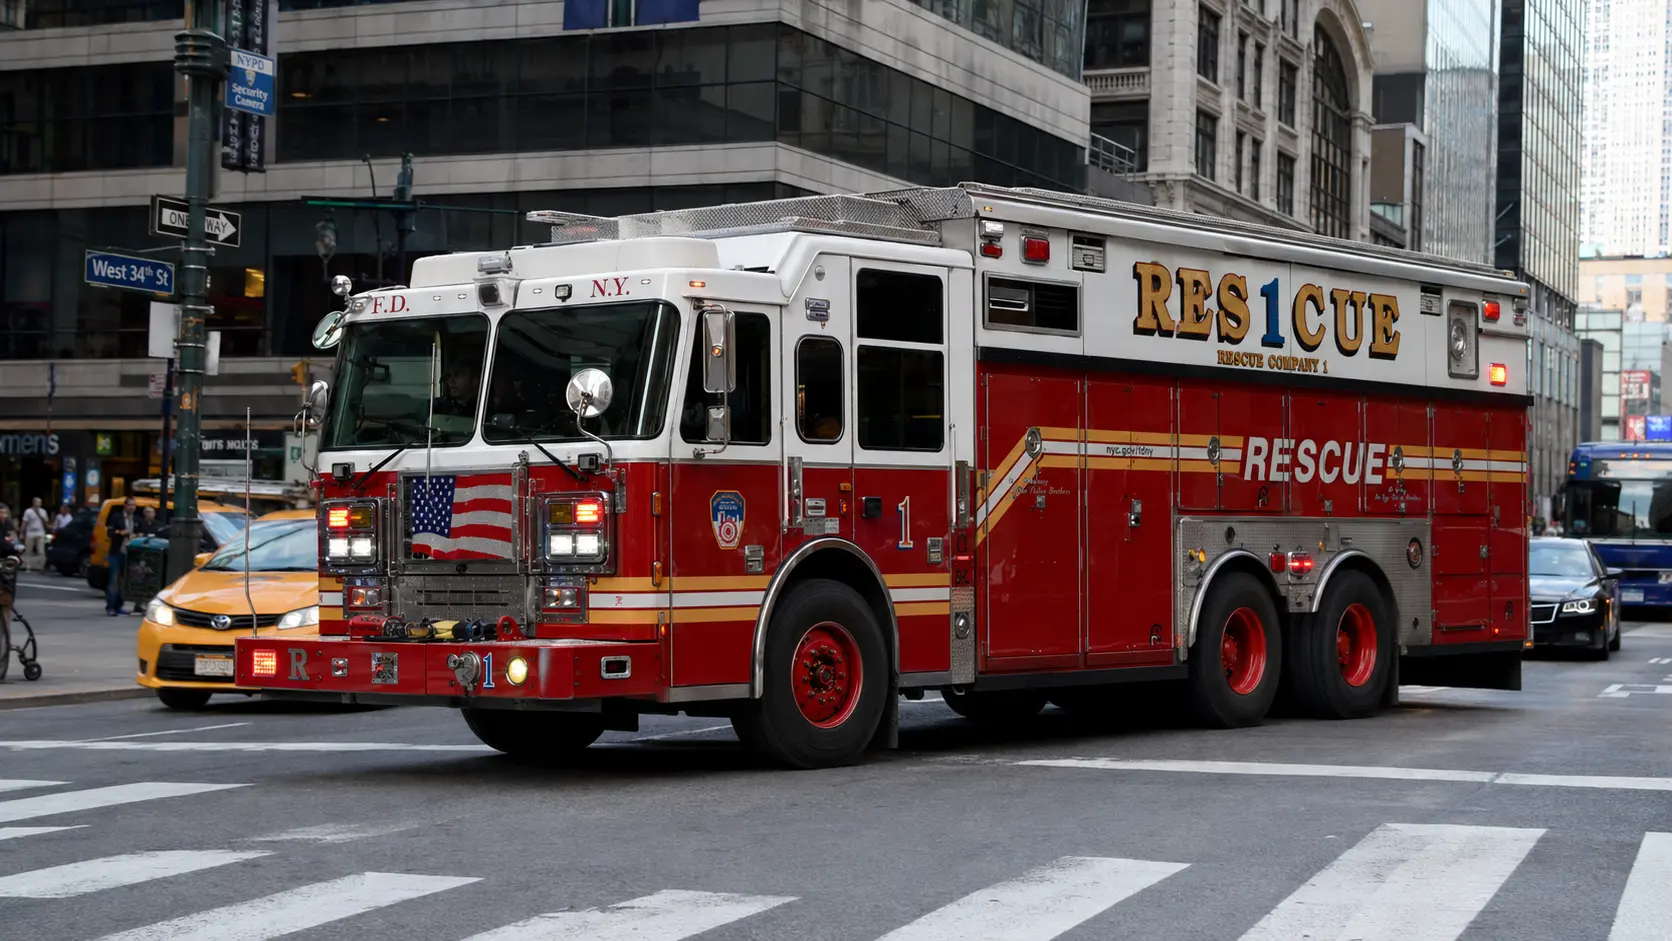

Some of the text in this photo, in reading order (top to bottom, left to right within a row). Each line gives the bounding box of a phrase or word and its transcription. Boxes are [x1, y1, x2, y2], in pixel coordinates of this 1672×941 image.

[237, 53, 264, 70] NYPD
[232, 83, 268, 102] Security
[235, 94, 265, 111] Camera
[207, 218, 228, 234] WAY
[92, 258, 169, 287] West 34th St
[590, 276, 630, 298] N.Y.
[371, 294, 410, 315] F.D.
[1217, 350, 1329, 373] RESCUE COMPANY 1
[0, 433, 60, 455] mens
[1244, 436, 1386, 485] RESCUE
[897, 496, 913, 550] 1
[288, 647, 310, 680] R
[483, 652, 495, 689] 1
